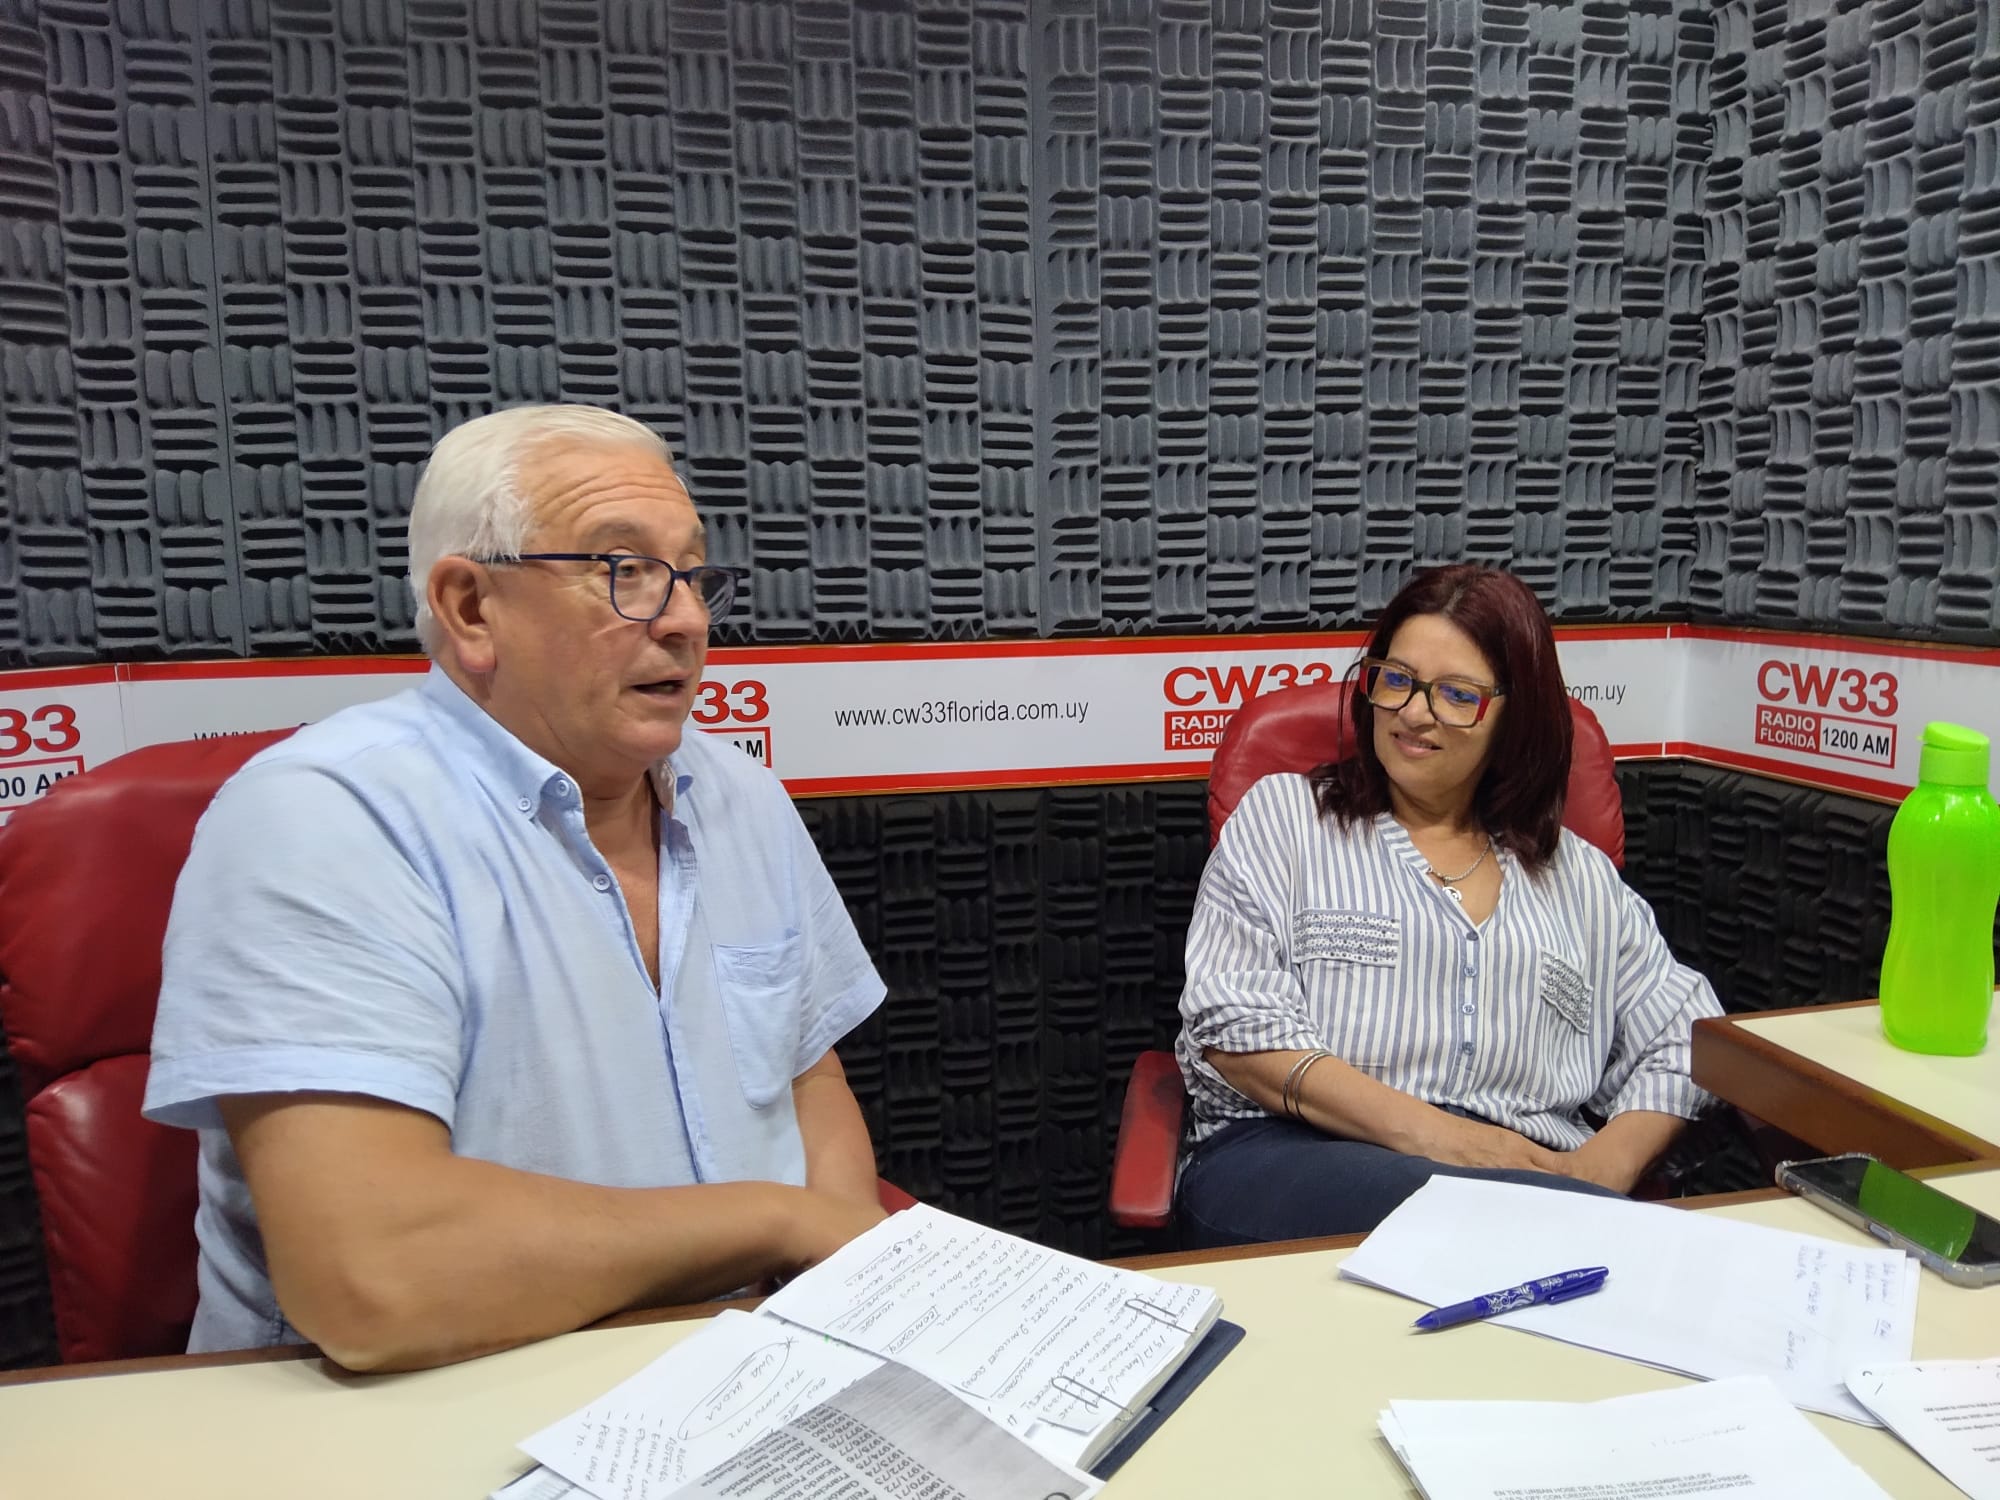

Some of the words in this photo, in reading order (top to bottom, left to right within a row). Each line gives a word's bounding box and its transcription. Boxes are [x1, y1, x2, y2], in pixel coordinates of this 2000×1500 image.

[1757, 660, 1898, 717] CW33
[835, 700, 1088, 727] www.cw33florida.com.uy
[1171, 714, 1232, 731] RADI
[1761, 710, 1816, 732] RADIO
[1171, 731, 1224, 747] FLORI
[1760, 727, 1817, 750] FLORIDA
[1822, 727, 1859, 752] 1200
[1862, 733, 1890, 757] AM
[828, 1423, 866, 1449] 1977/78
[840, 1429, 876, 1456] 1976/77
[846, 1436, 885, 1462] 1975/76
[856, 1442, 895, 1469] 1974/75
[865, 1449, 904, 1477] 1973/74
[736, 1464, 786, 1497] Fernández
[803, 1465, 841, 1490] Ricardo
[875, 1456, 914, 1485] 1972/73
[884, 1463, 924, 1492] 1971/72
[895, 1470, 934, 1499] 1970/71
